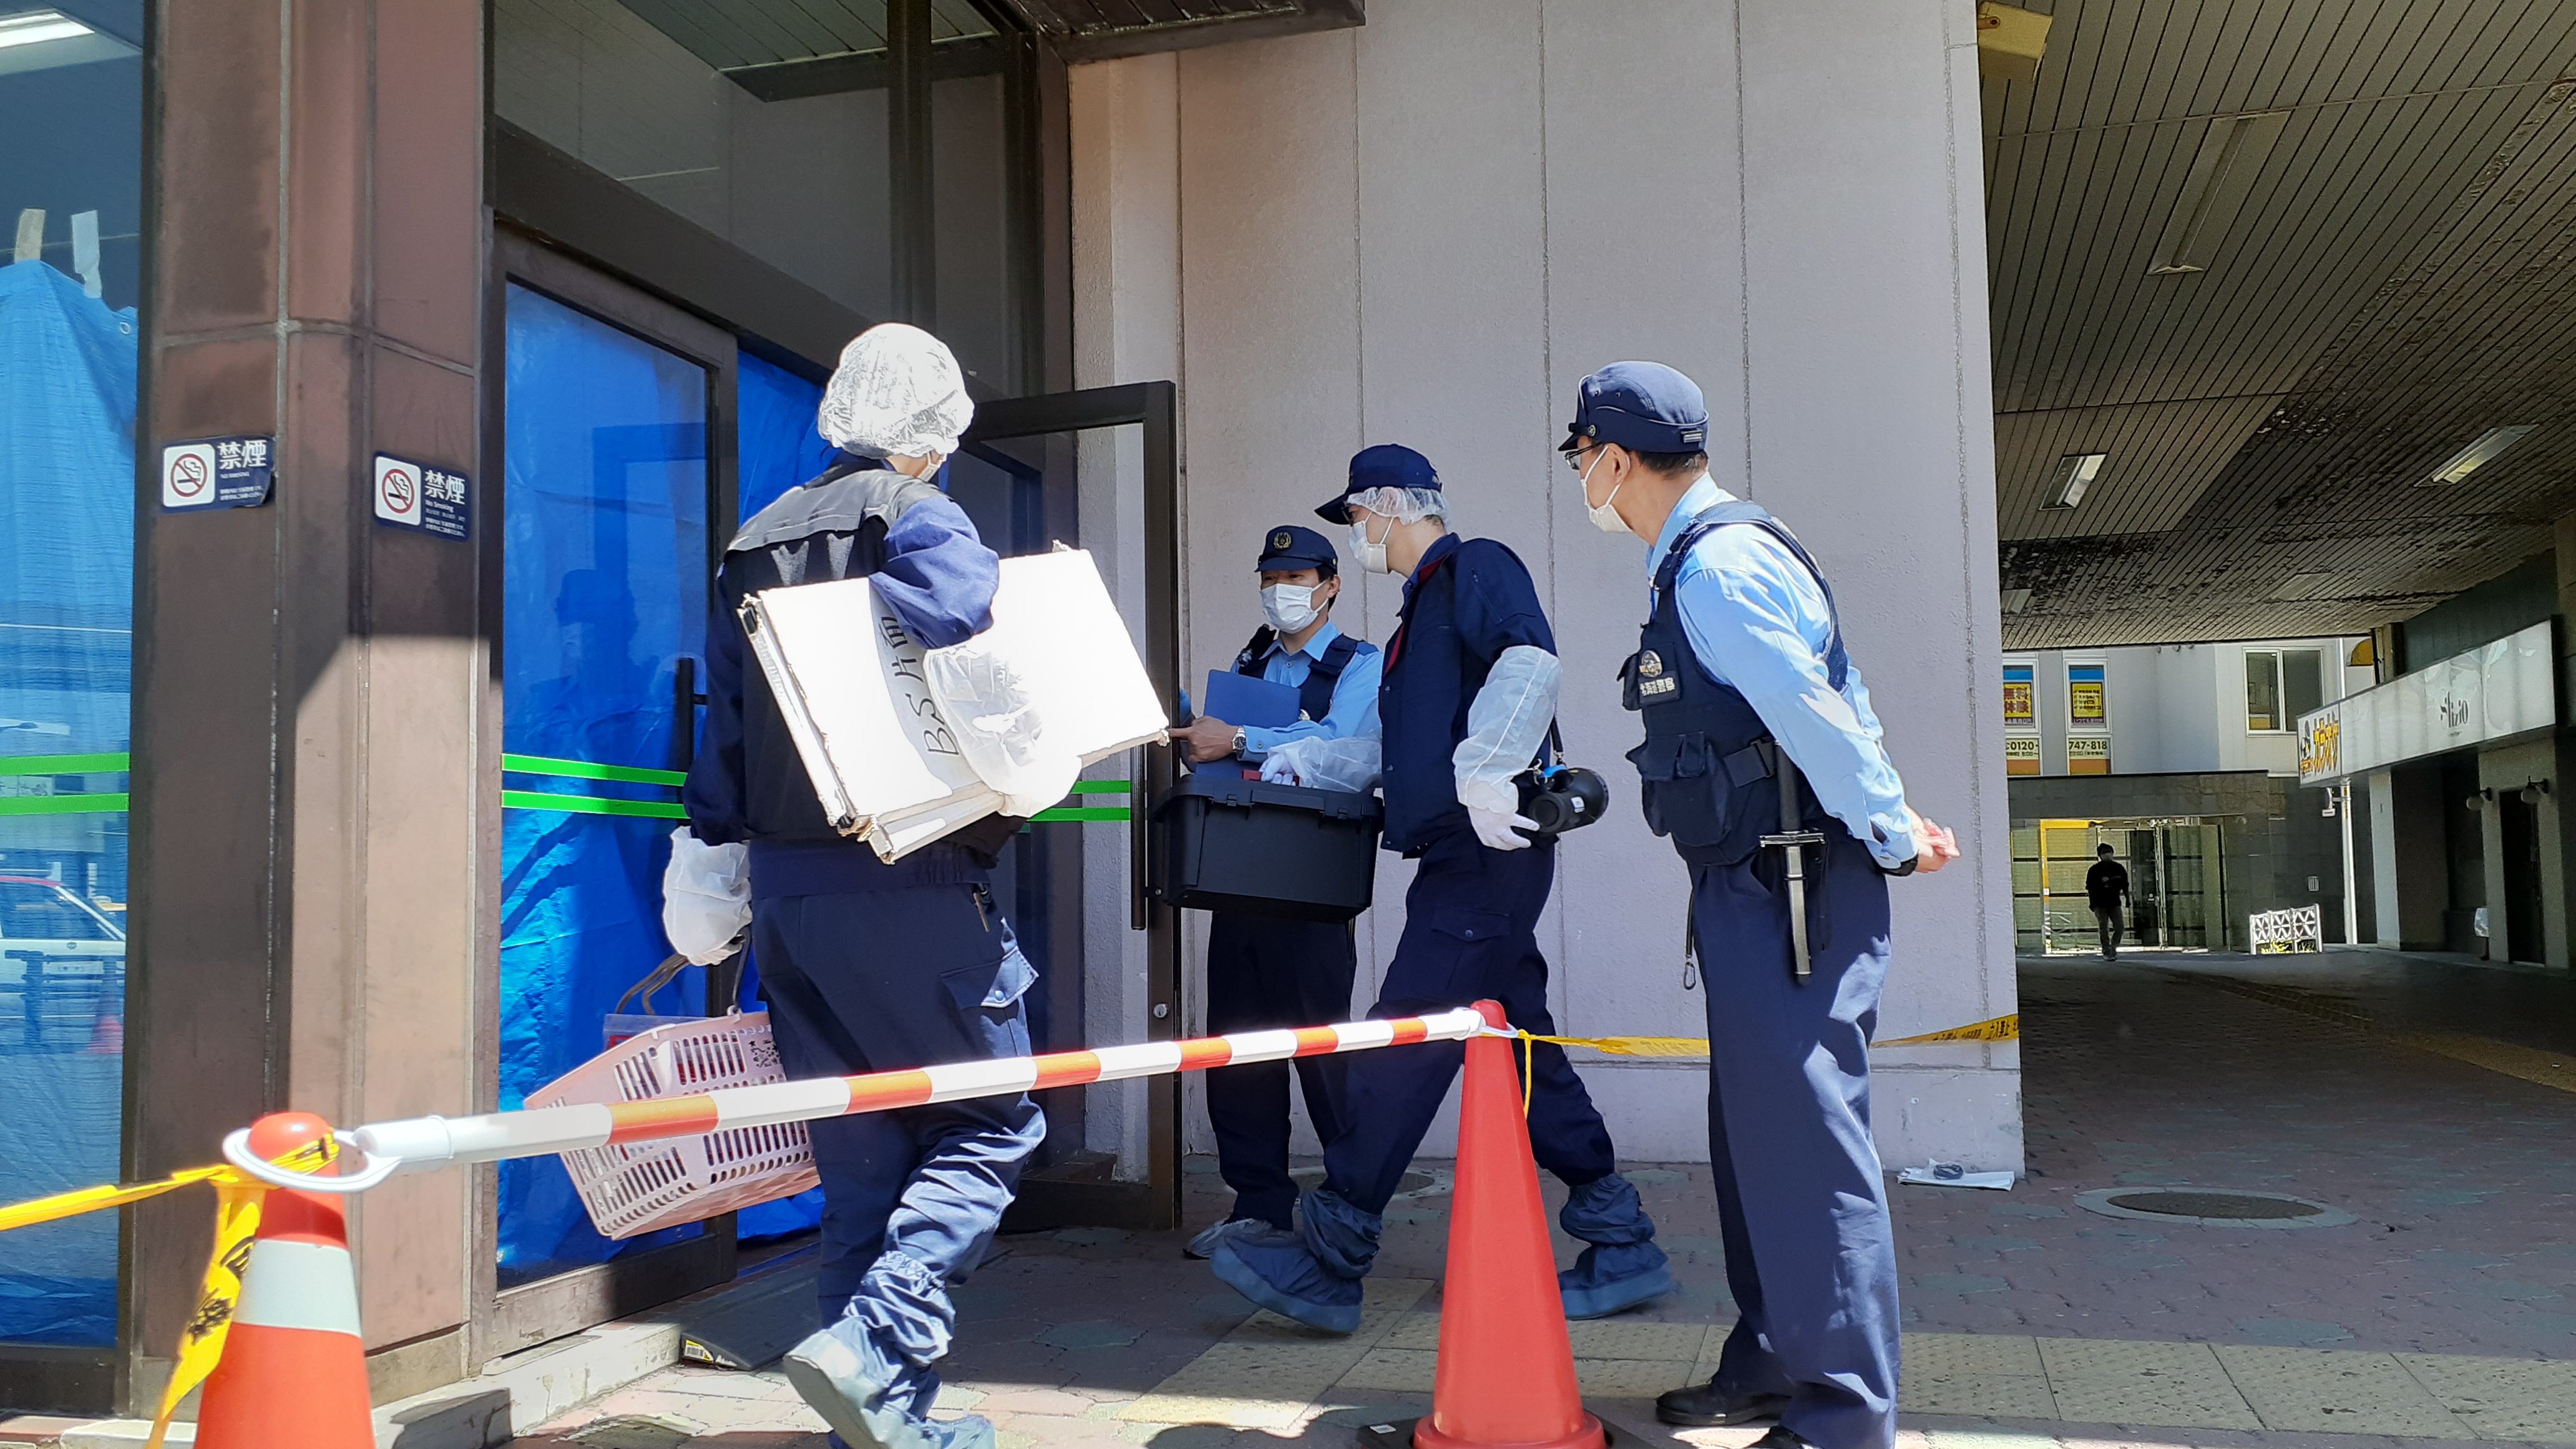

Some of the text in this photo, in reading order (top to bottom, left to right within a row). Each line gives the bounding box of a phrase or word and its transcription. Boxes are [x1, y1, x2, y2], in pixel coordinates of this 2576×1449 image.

[217, 439, 268, 470] 禁煙
[424, 469, 466, 505] 禁煙
[2069, 741, 2107, 750] 747-818
[2313, 710, 2339, 776] カラオケ
